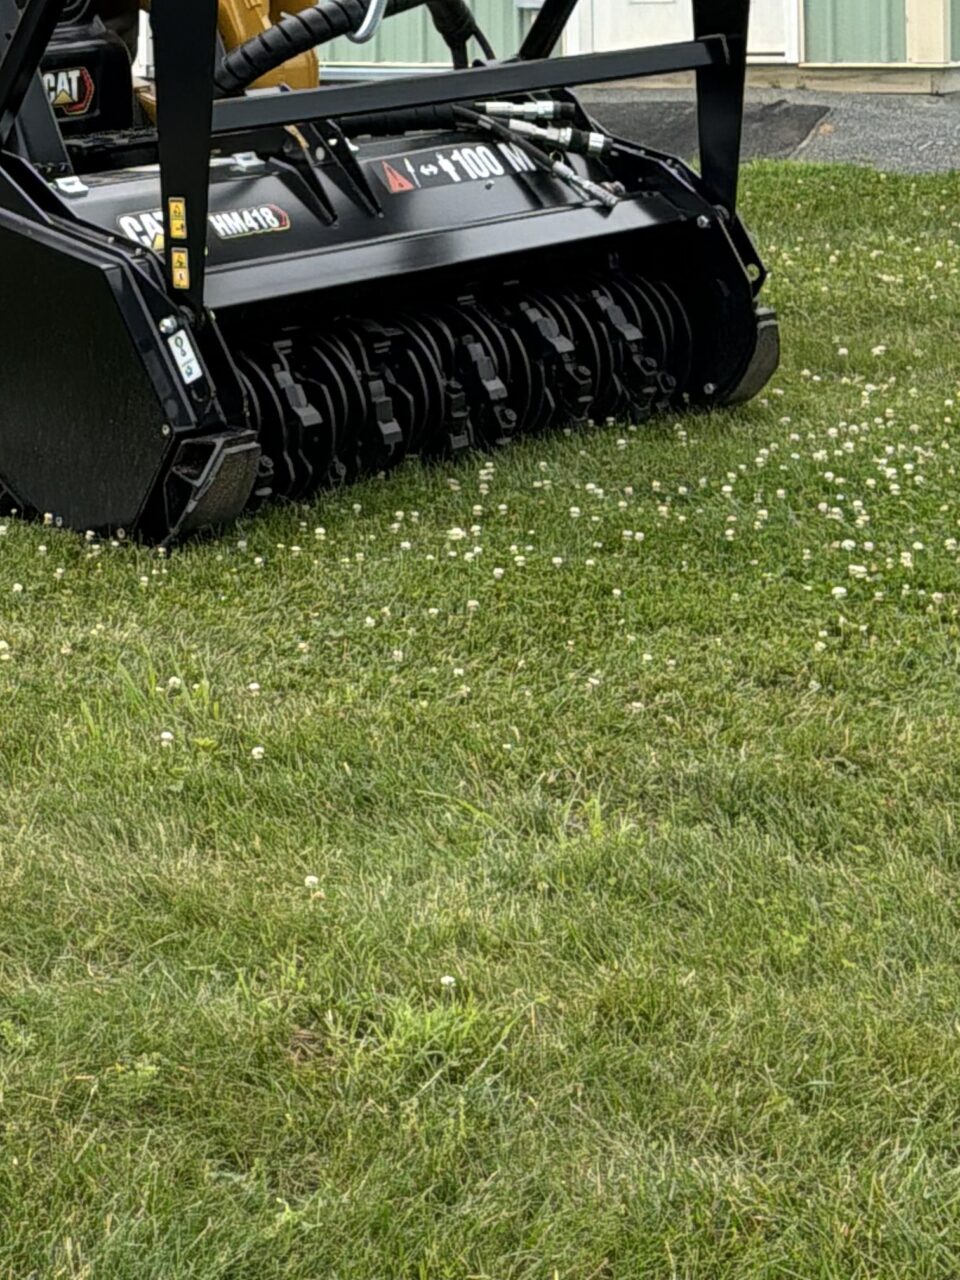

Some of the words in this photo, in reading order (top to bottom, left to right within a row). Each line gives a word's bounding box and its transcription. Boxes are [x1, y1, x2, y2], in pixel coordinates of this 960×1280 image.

[42, 70, 80, 104] CAT
[451, 145, 504, 179] 100
[208, 207, 280, 237] HM418
